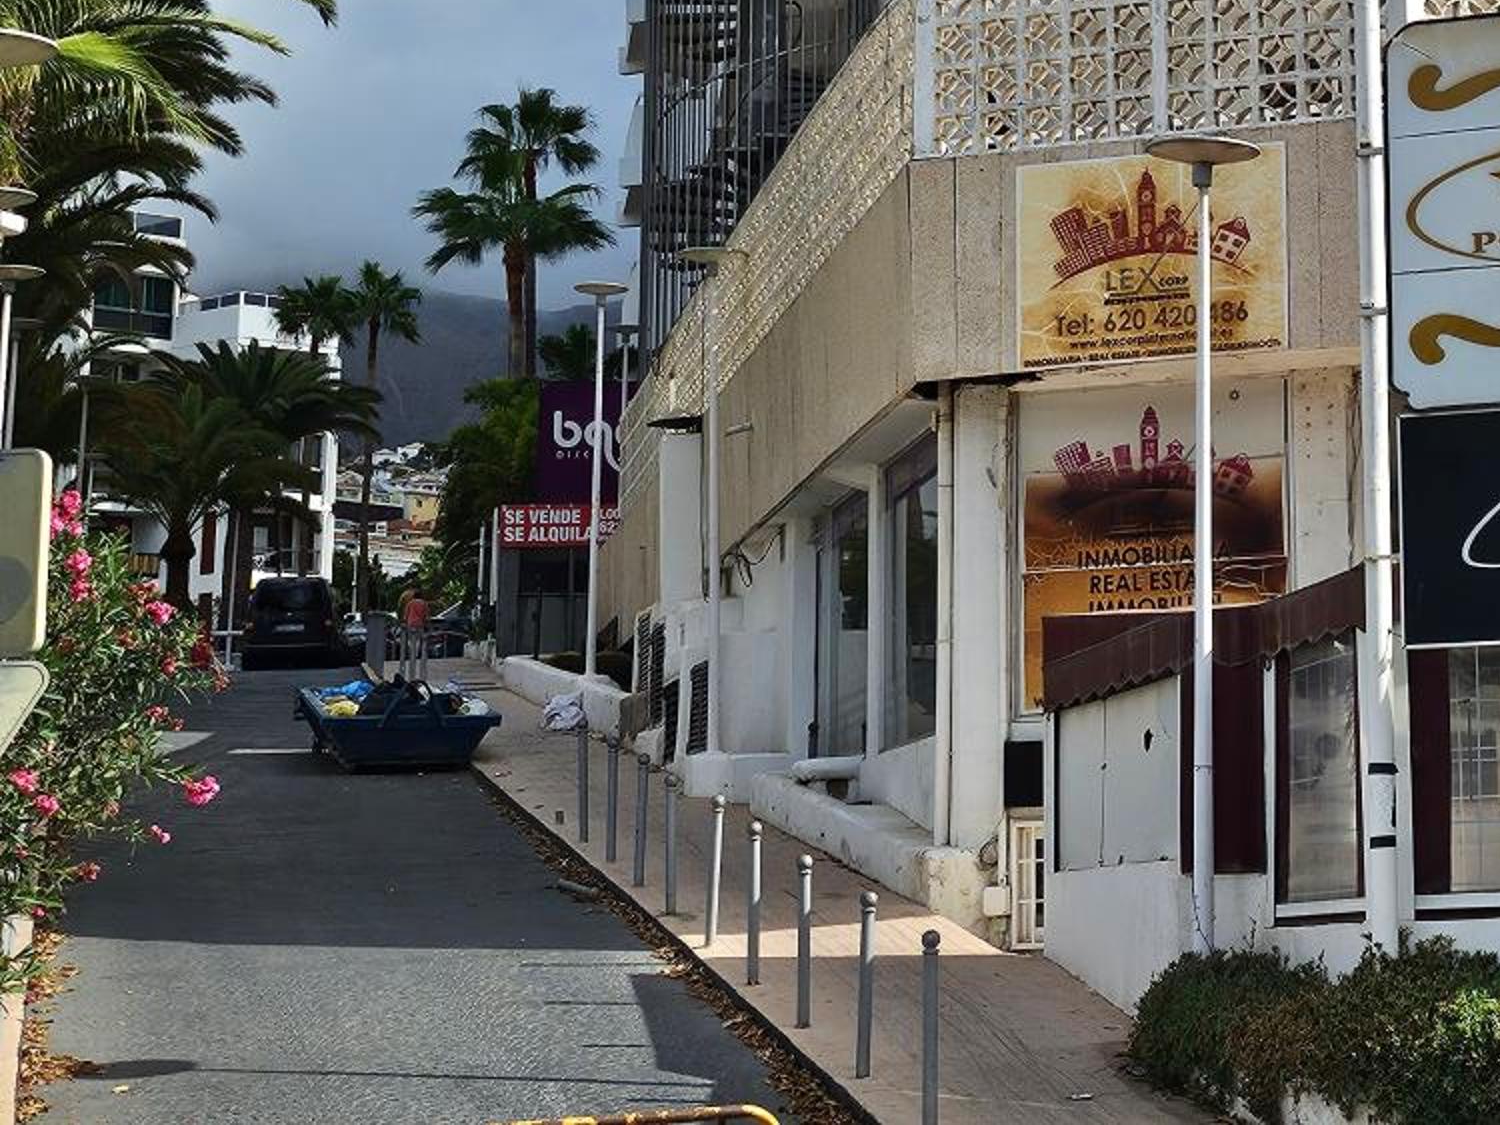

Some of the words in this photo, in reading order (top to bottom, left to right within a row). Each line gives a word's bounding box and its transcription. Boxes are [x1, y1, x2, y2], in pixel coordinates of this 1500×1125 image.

[1104, 308, 1146, 332] 620
[1153, 305, 1196, 327] 420
[504, 508, 525, 524] SE
[529, 508, 581, 524] VENDE
[503, 526, 525, 542] SE
[1089, 572, 1142, 594] REAL
